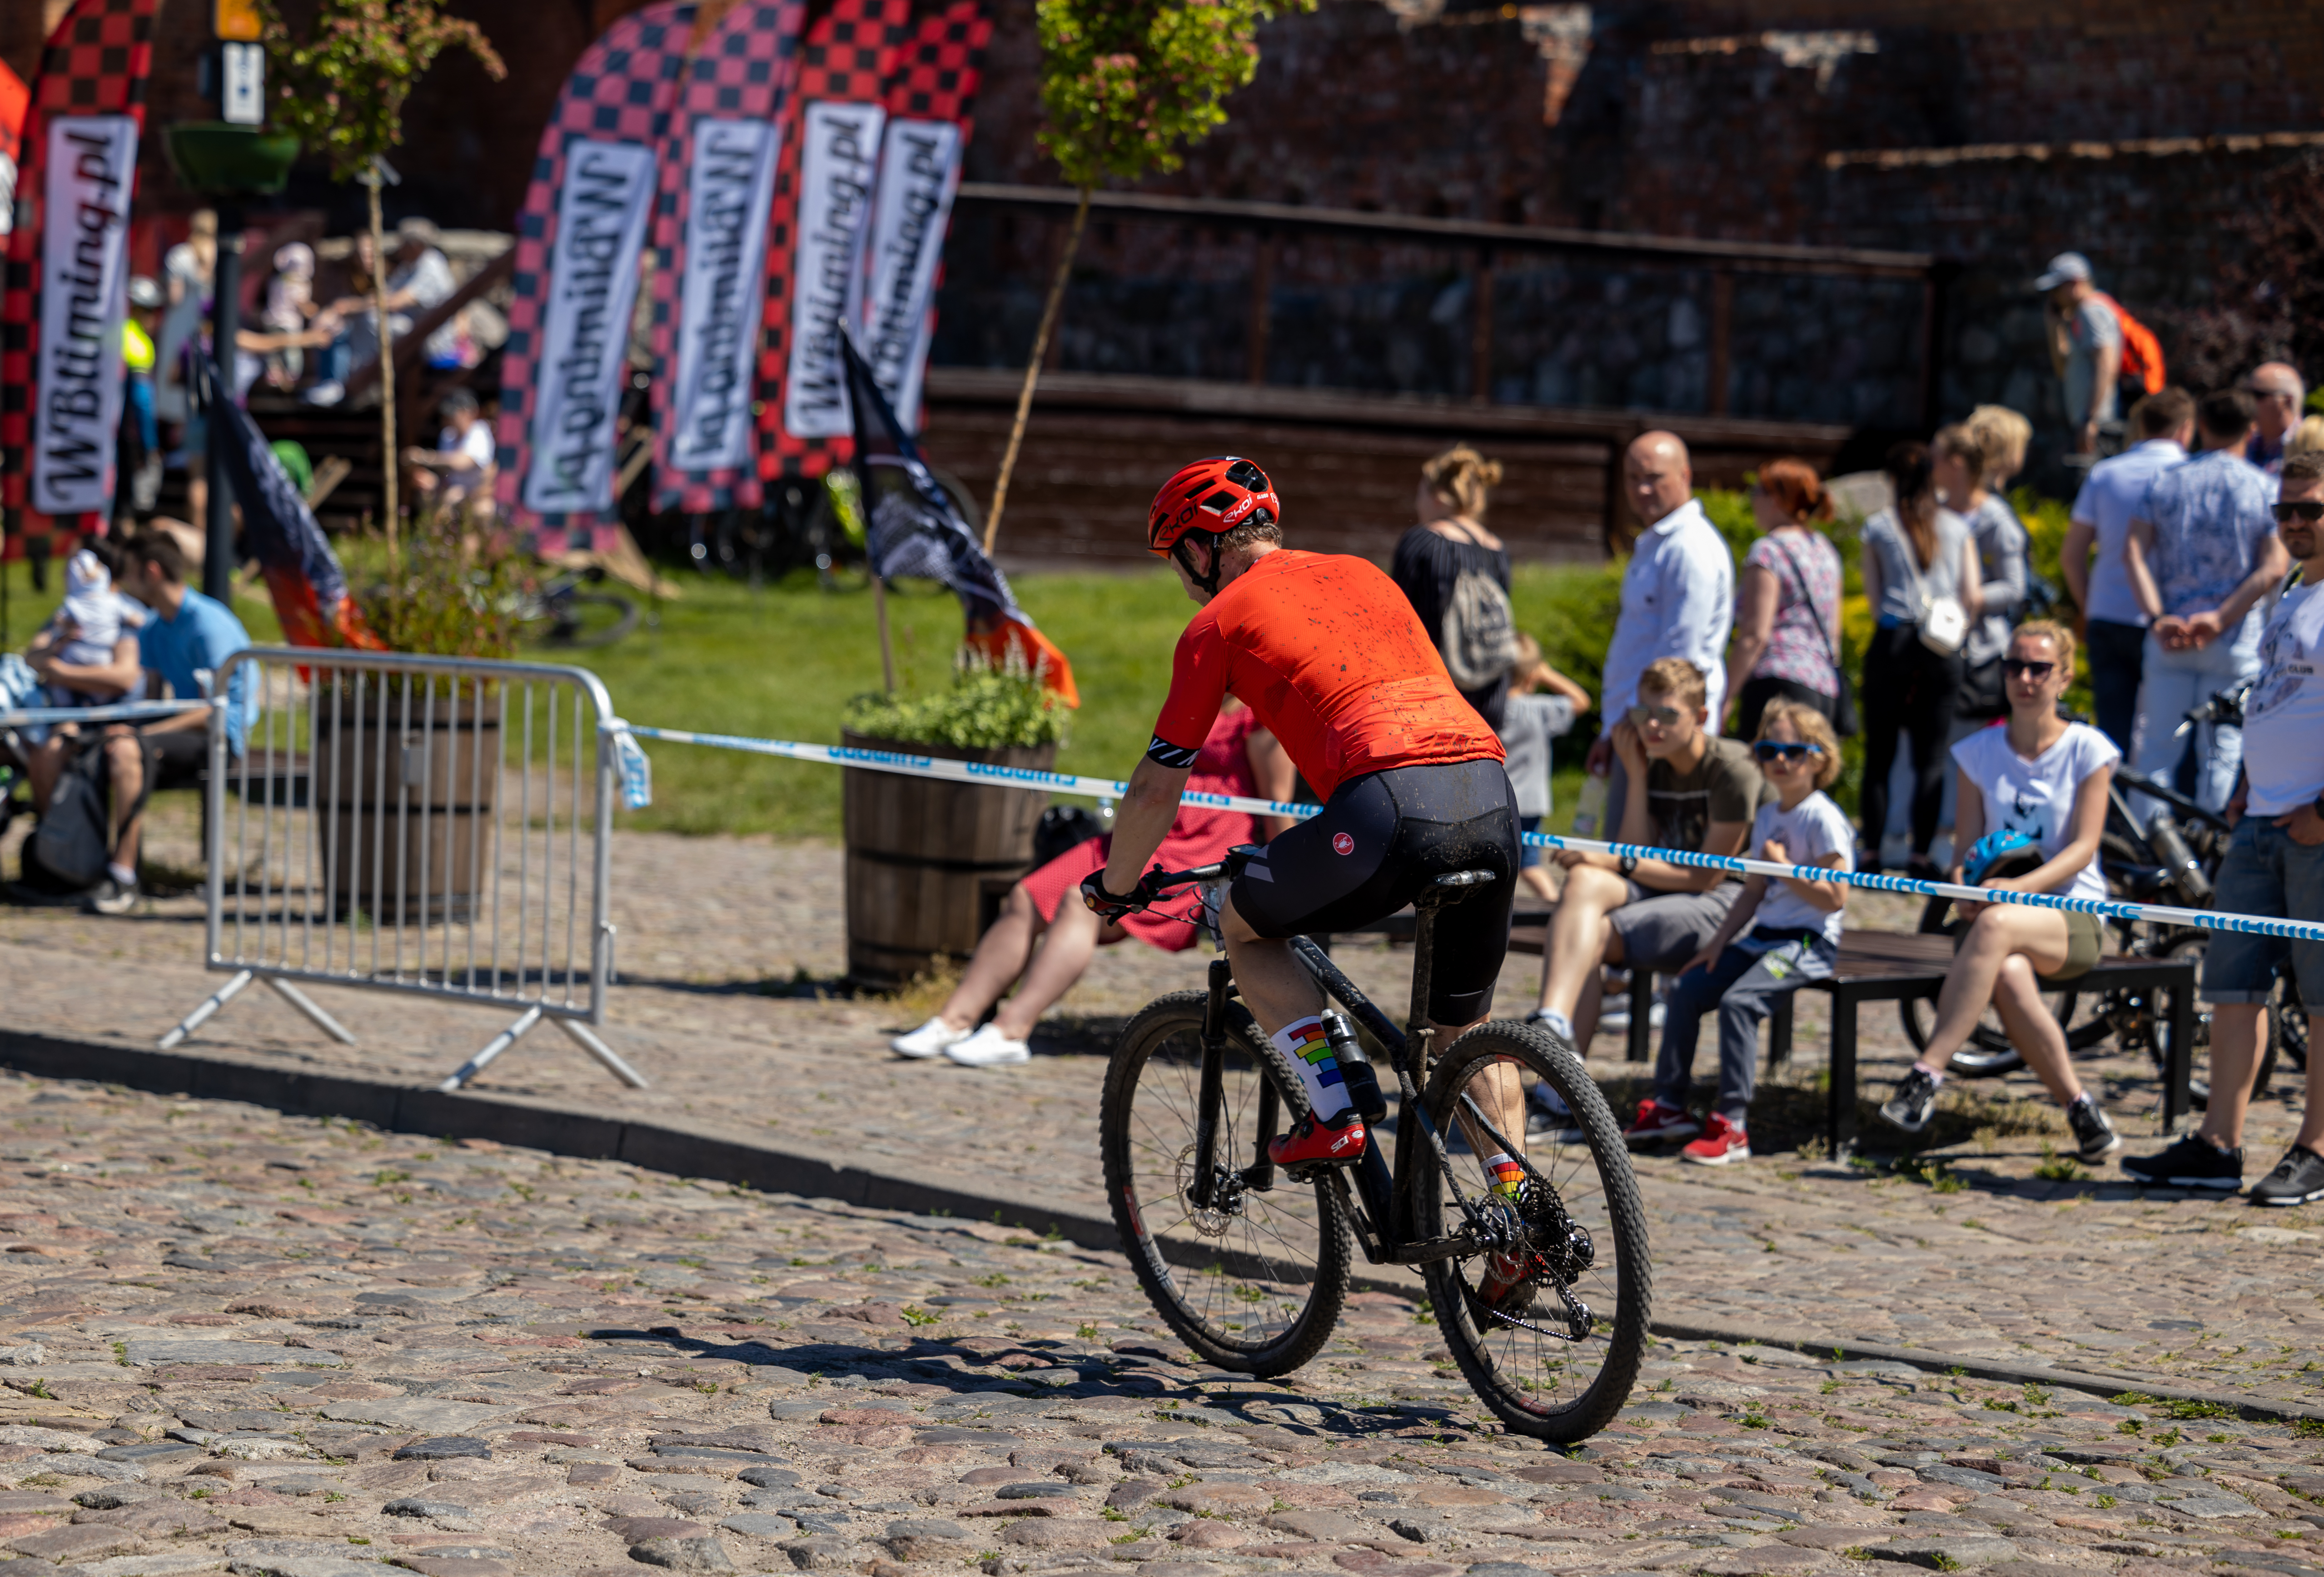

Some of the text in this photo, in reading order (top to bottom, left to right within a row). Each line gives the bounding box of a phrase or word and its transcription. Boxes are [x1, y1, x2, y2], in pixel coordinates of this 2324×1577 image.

[867, 131, 941, 394] Btiming.pl
[46, 131, 121, 501] WBtiming.pl
[2288, 664, 2314, 674] CLUB
[2193, 914, 2324, 941] HIMANO
[1331, 1135, 1349, 1153] SIDI
